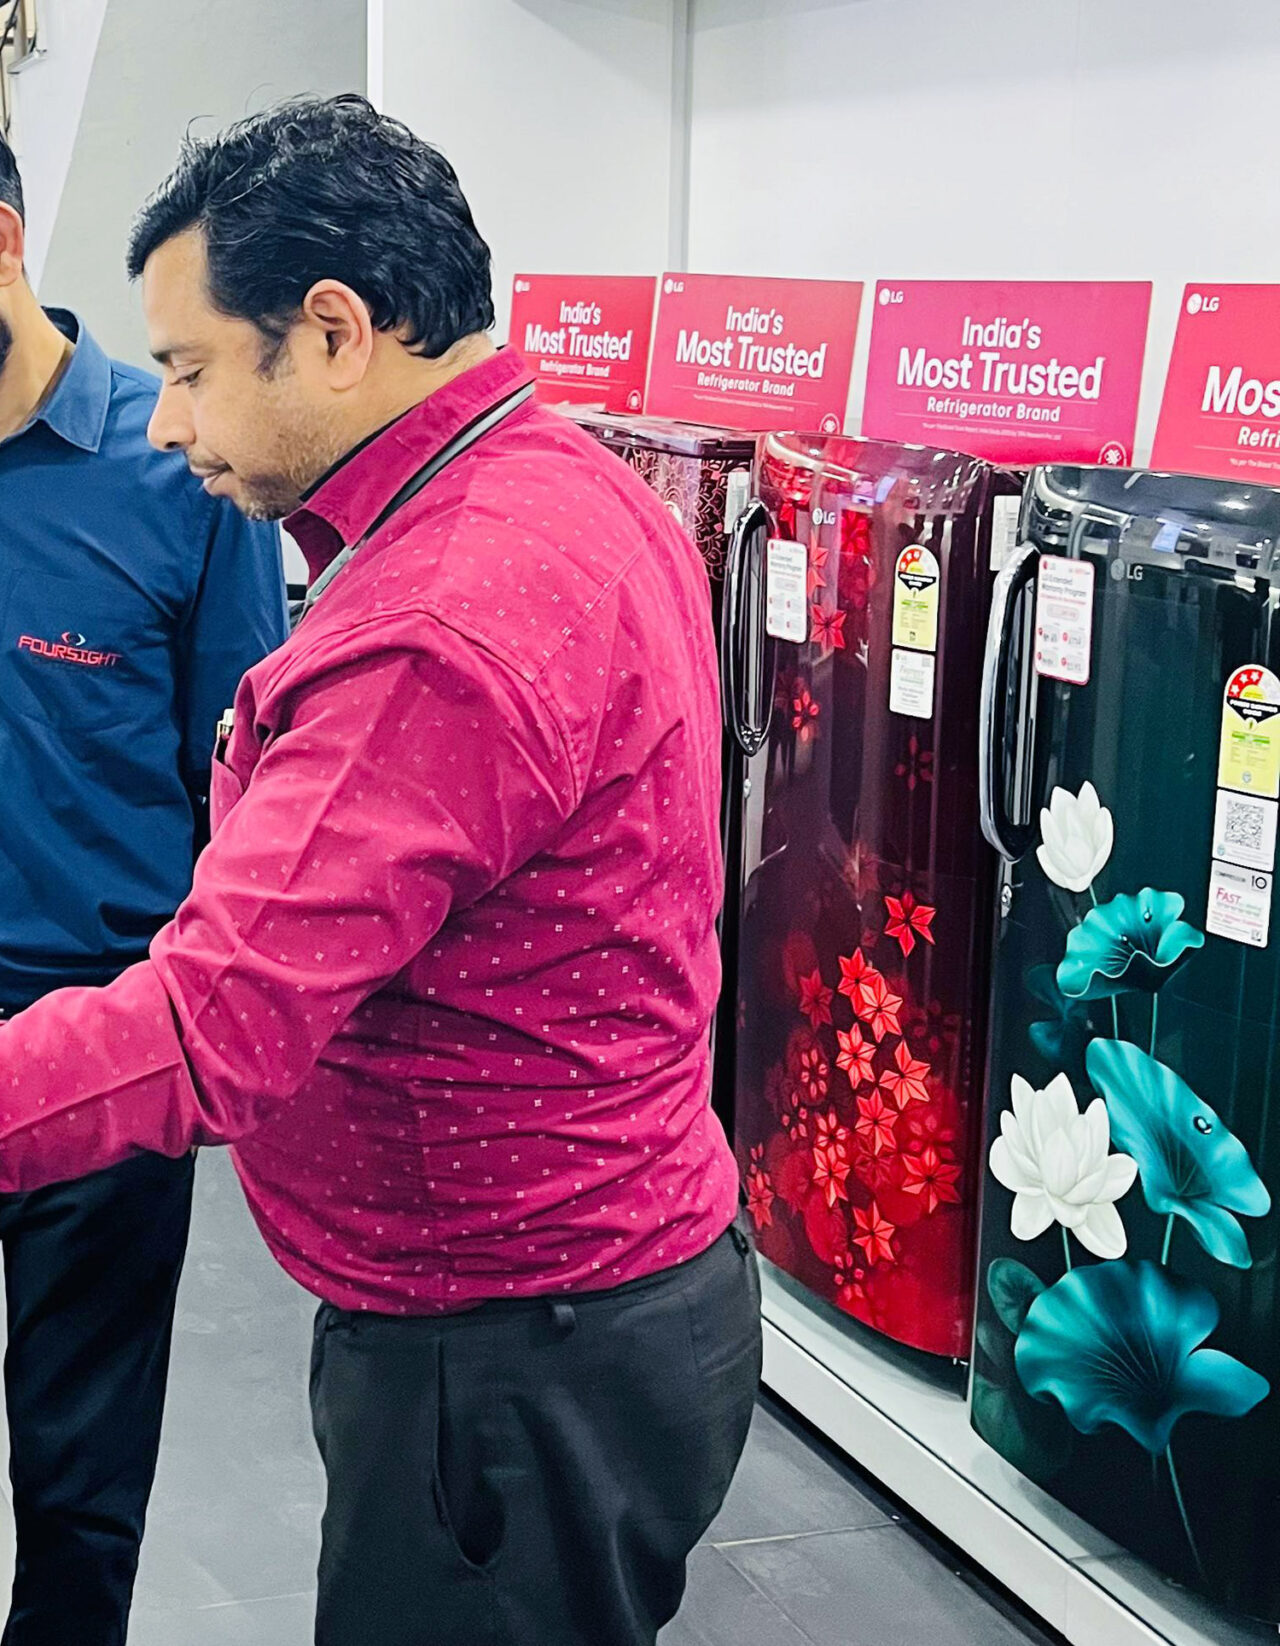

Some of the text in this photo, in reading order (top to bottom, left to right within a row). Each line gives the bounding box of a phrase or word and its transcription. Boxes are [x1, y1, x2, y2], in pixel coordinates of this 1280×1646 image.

[673, 281, 684, 293] LG
[890, 290, 904, 304] LG
[559, 300, 602, 326] India's
[1201, 297, 1220, 312] LG
[725, 305, 784, 336] India's
[961, 316, 1042, 350] India's
[524, 323, 633, 361] Most Trusted
[676, 329, 827, 378] Most Trusted
[540, 359, 610, 378] Refrigerator Brand
[897, 347, 1106, 400] Most Trusted
[697, 372, 795, 397] Refrigerator Brand
[927, 396, 1061, 422] Refrigerator Brand
[824, 511, 836, 525] LG
[1126, 563, 1144, 581] LG
[18, 634, 123, 666] FOURSIGHT
[1215, 885, 1242, 906] FAST
